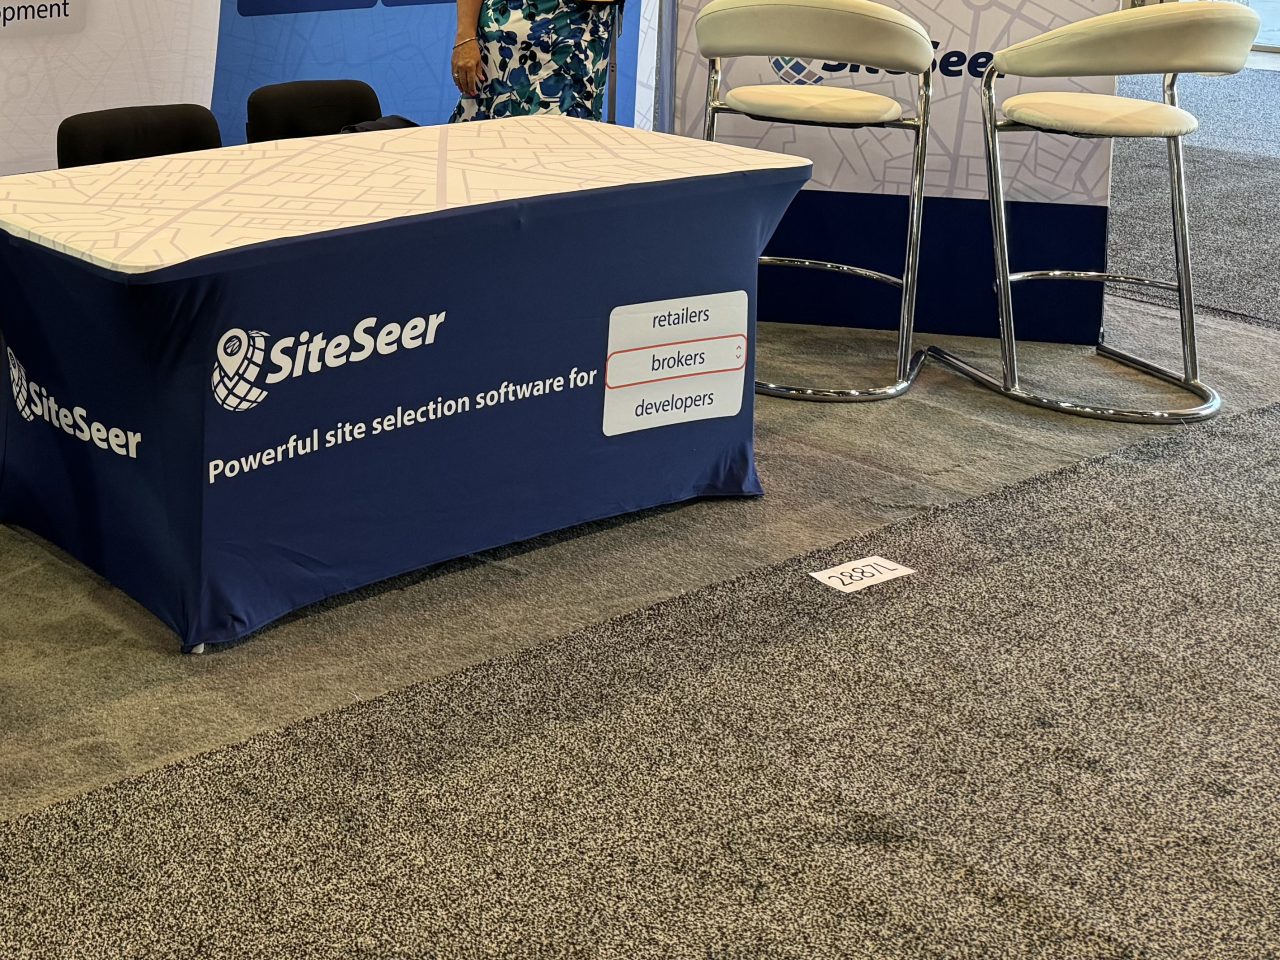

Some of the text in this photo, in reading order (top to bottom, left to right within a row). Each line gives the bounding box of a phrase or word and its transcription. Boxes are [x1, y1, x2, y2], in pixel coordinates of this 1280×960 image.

[652, 306, 710, 329] retailers
[265, 311, 447, 384] SiteSeer
[29, 381, 142, 459] SiteSeer
[209, 349, 706, 484] Powerful site selection software for brokers
[634, 390, 715, 418] developers
[828, 562, 898, 587] 2887L
